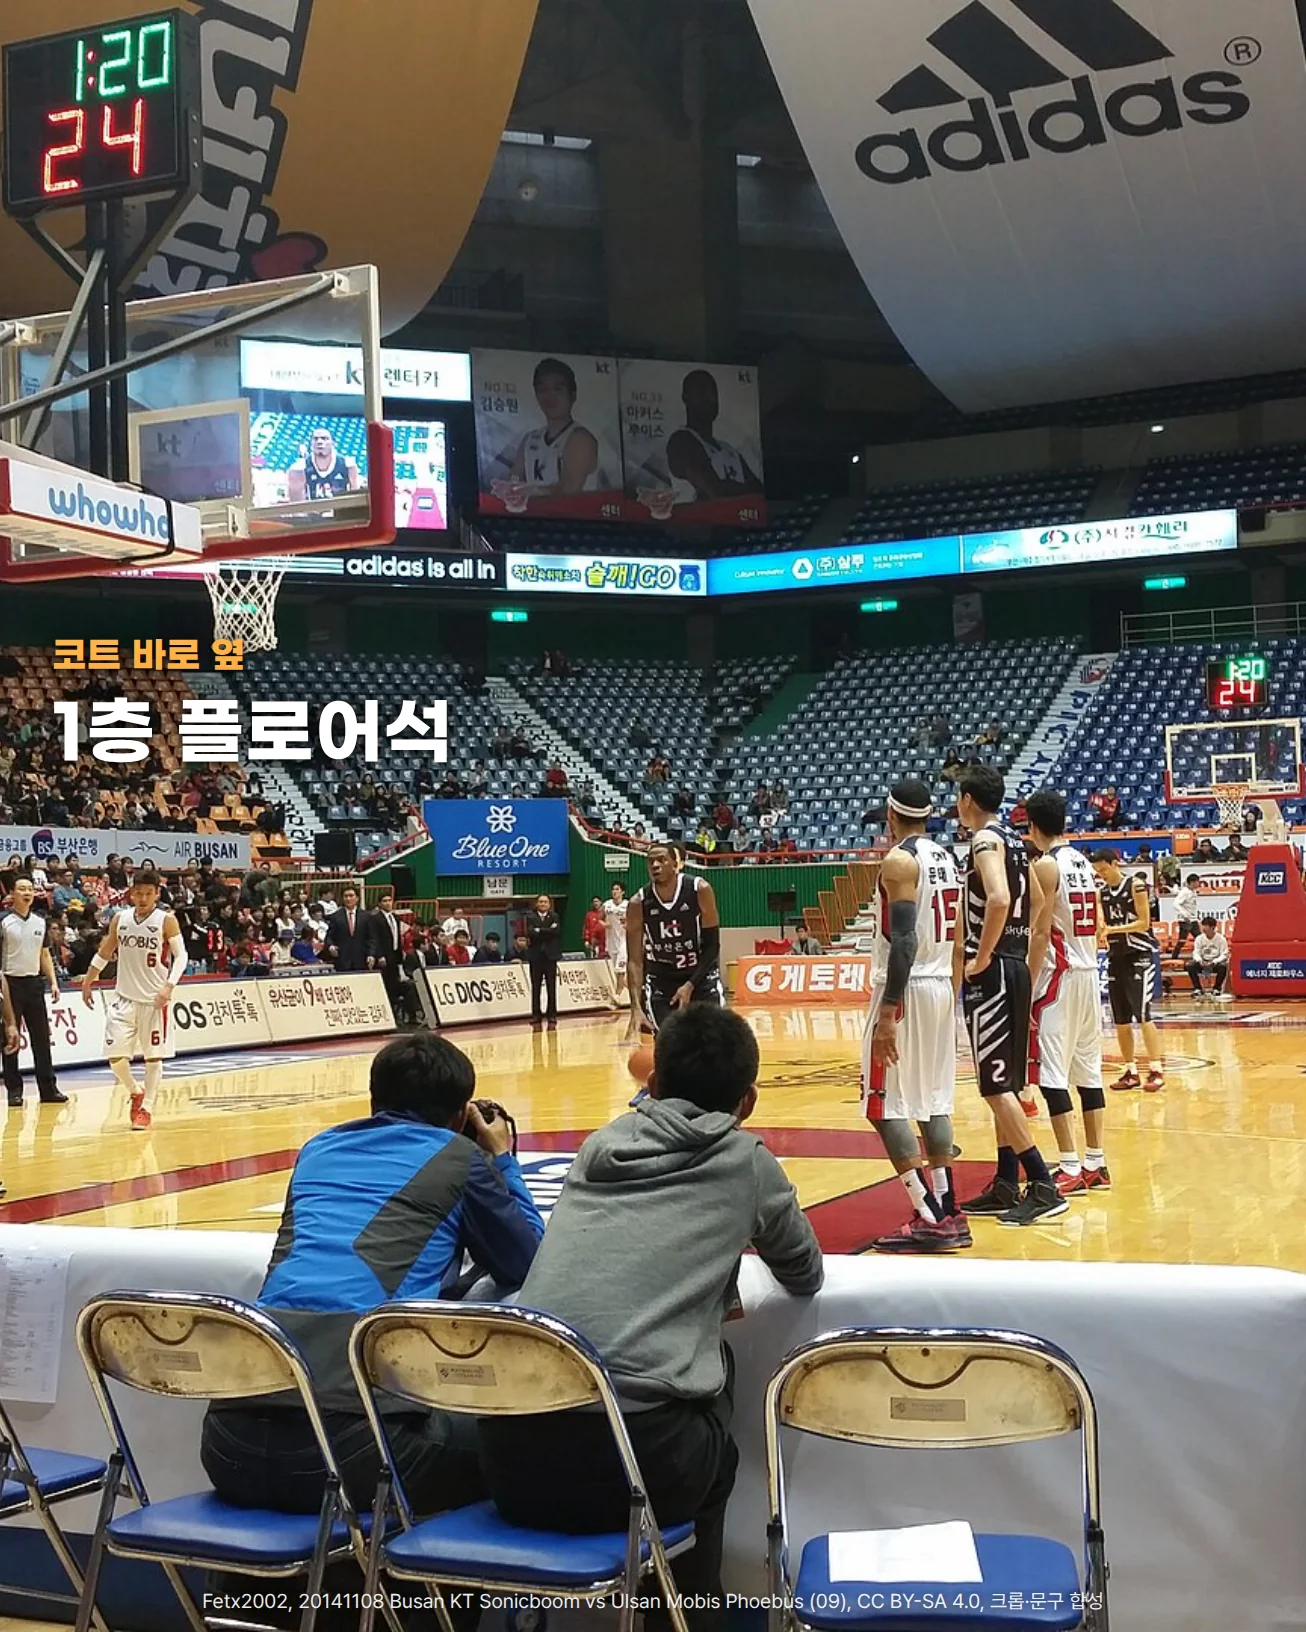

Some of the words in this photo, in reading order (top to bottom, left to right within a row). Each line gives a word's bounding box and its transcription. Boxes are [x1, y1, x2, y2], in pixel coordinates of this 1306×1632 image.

[74, 21, 171, 101] 1:20
[855, 70, 1251, 184] adidas
[43, 98, 144, 192] 24
[595, 360, 611, 374] kt
[384, 367, 440, 388] 렌터카
[738, 370, 754, 384] kt
[481, 396, 519, 413] 김승원
[627, 405, 665, 421] 마커스
[600, 503, 621, 517] 센터
[738, 508, 759, 522] 센터
[346, 555, 423, 579] adidas
[427, 556, 445, 579] is
[449, 557, 473, 579] all
[477, 558, 496, 580] in
[1219, 680, 1256, 705] 24
[57, 837, 98, 856] 부산은행
[173, 841, 192, 857] AIR
[194, 842, 238, 859] BUSAN
[477, 858, 528, 868] RESORT
[1259, 872, 1283, 884] KCC
[931, 888, 959, 943] 15
[1069, 891, 1097, 938] 23
[659, 919, 683, 939] kt
[118, 935, 158, 949] MOBIS
[654, 940, 694, 953] 부산은행
[146, 952, 157, 968] 6
[676, 952, 698, 969] 23
[745, 963, 774, 993] G
[778, 963, 873, 992] 게토레
[268, 986, 306, 1009] 유산균이
[325, 987, 337, 1004] 더
[434, 982, 456, 1006] LG
[454, 979, 493, 1004] DIOS
[206, 1001, 260, 1026] 김치톡톡
[151, 1030, 160, 1046] 6
[991, 1059, 1006, 1083] 2
